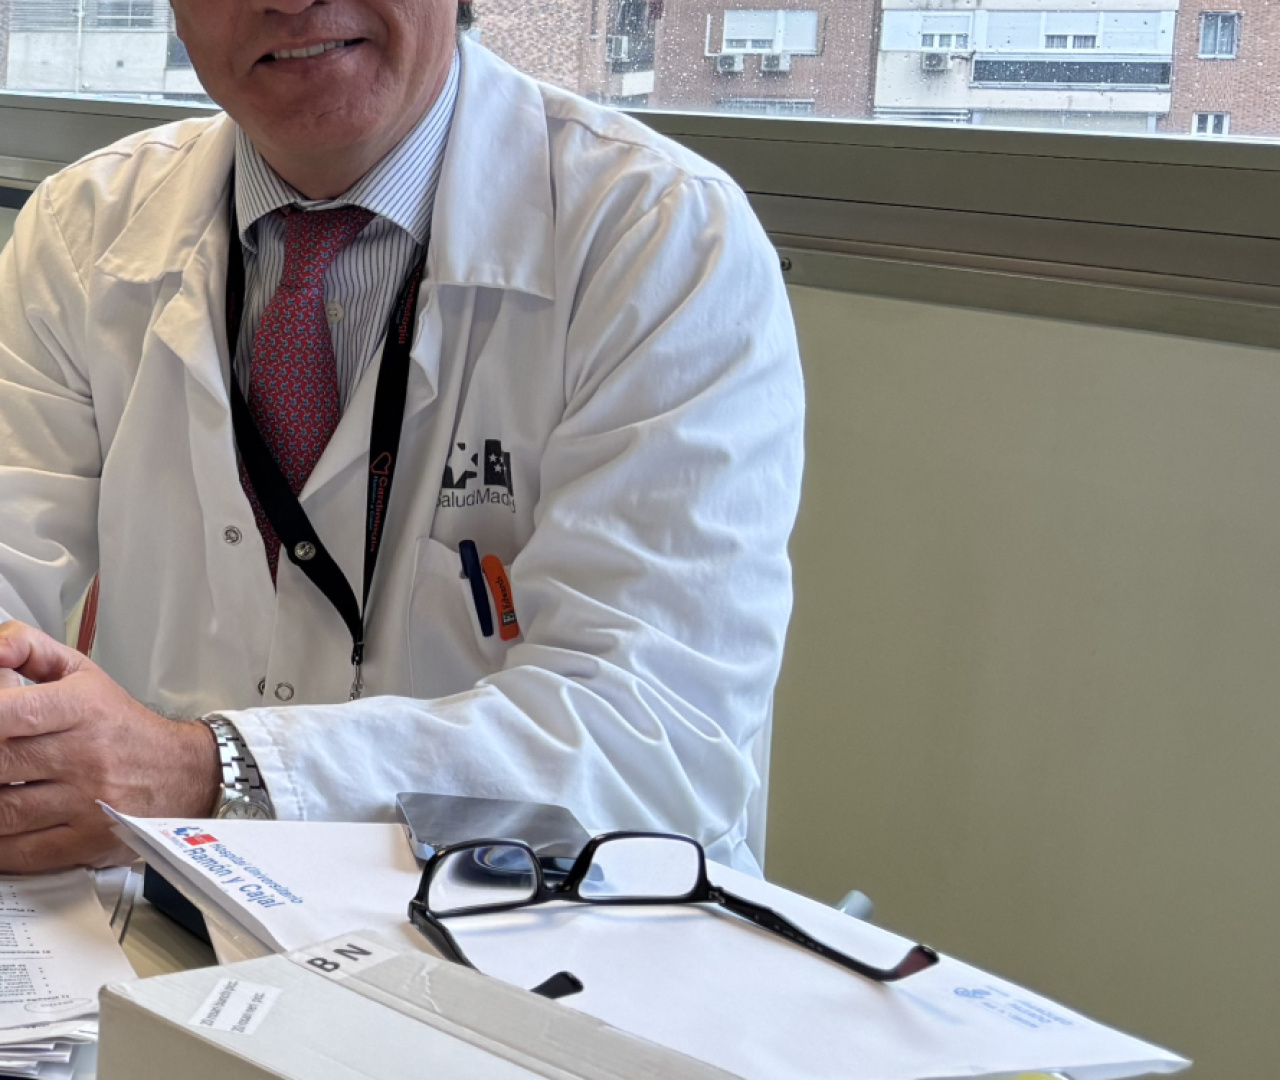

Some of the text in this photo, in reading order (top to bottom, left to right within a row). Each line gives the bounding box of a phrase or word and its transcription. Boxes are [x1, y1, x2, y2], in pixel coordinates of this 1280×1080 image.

[184, 847, 286, 909] Ramón y Cajal
[209, 843, 304, 904] Hospital Universitario
[306, 943, 373, 973] B N
